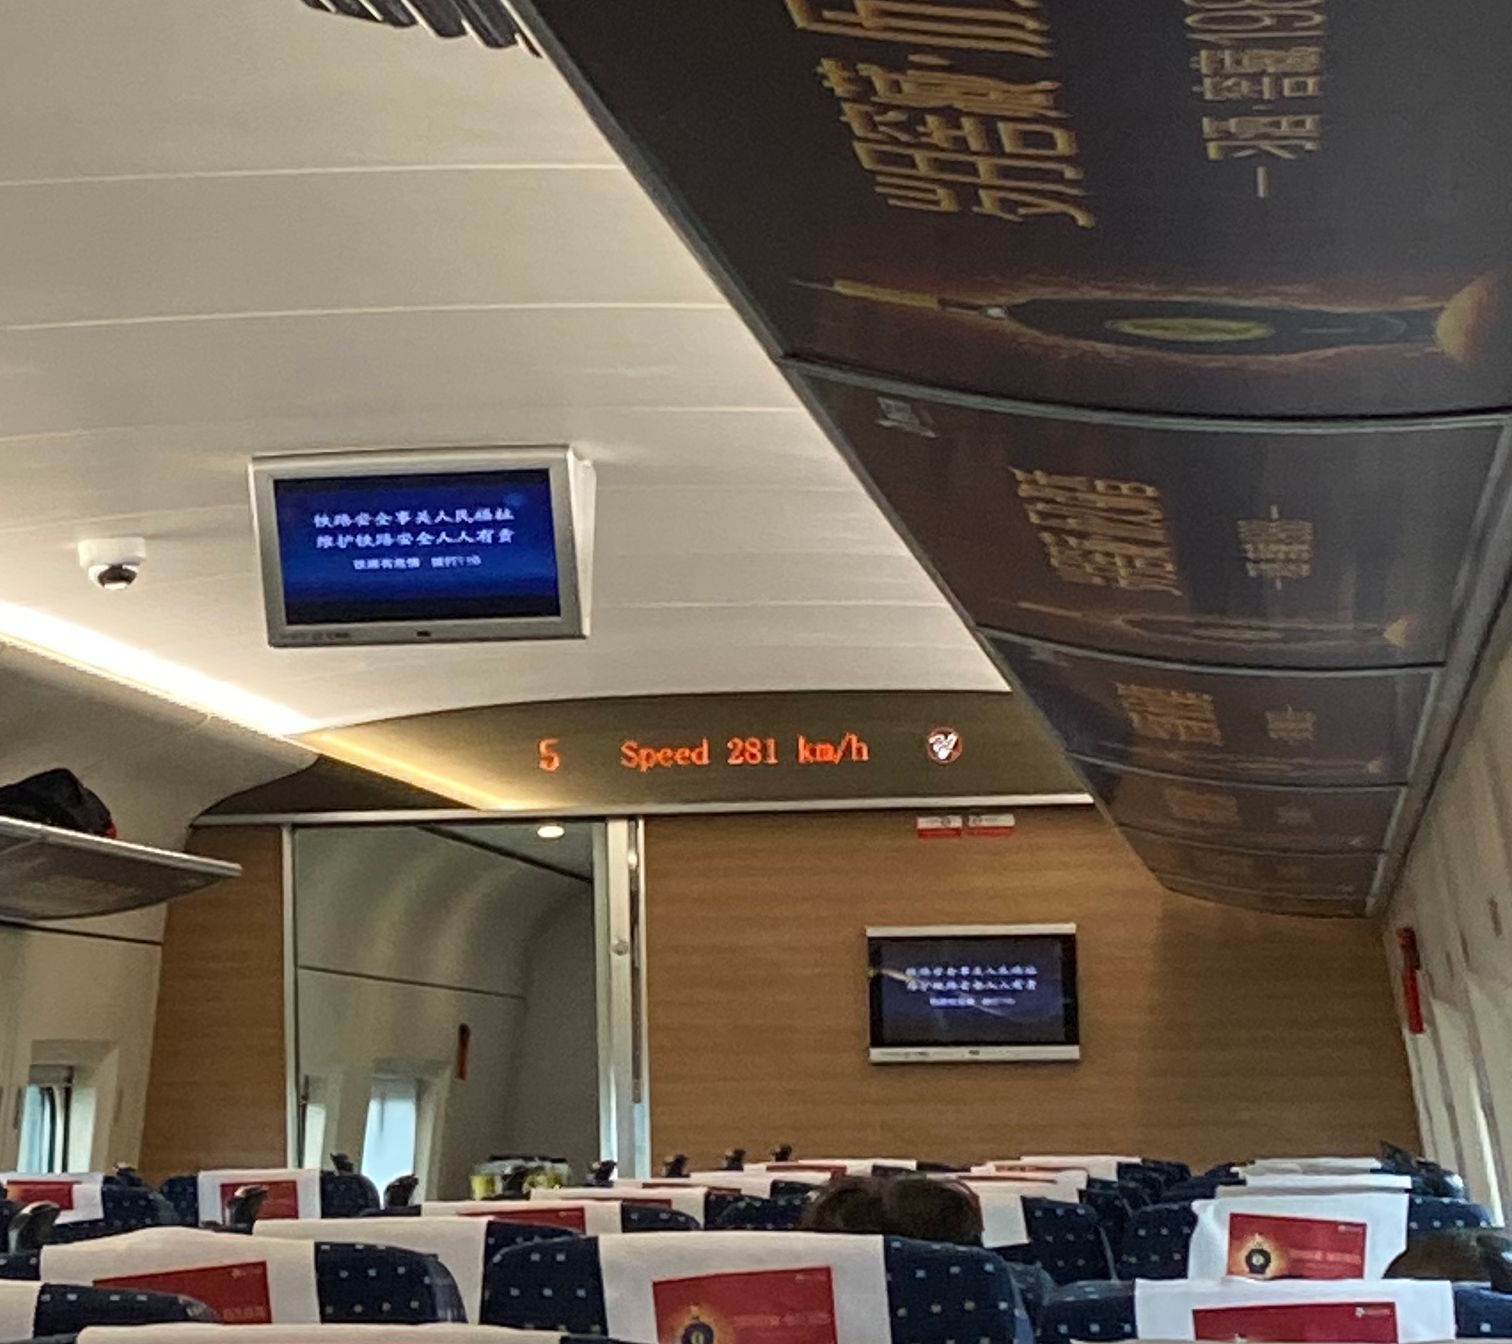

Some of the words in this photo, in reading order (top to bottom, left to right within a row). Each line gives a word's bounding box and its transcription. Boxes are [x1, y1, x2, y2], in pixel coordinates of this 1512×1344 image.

[539, 738, 561, 773] 5
[620, 738, 710, 772] Speed
[727, 736, 779, 766] 281
[798, 731, 870, 766] km/h
